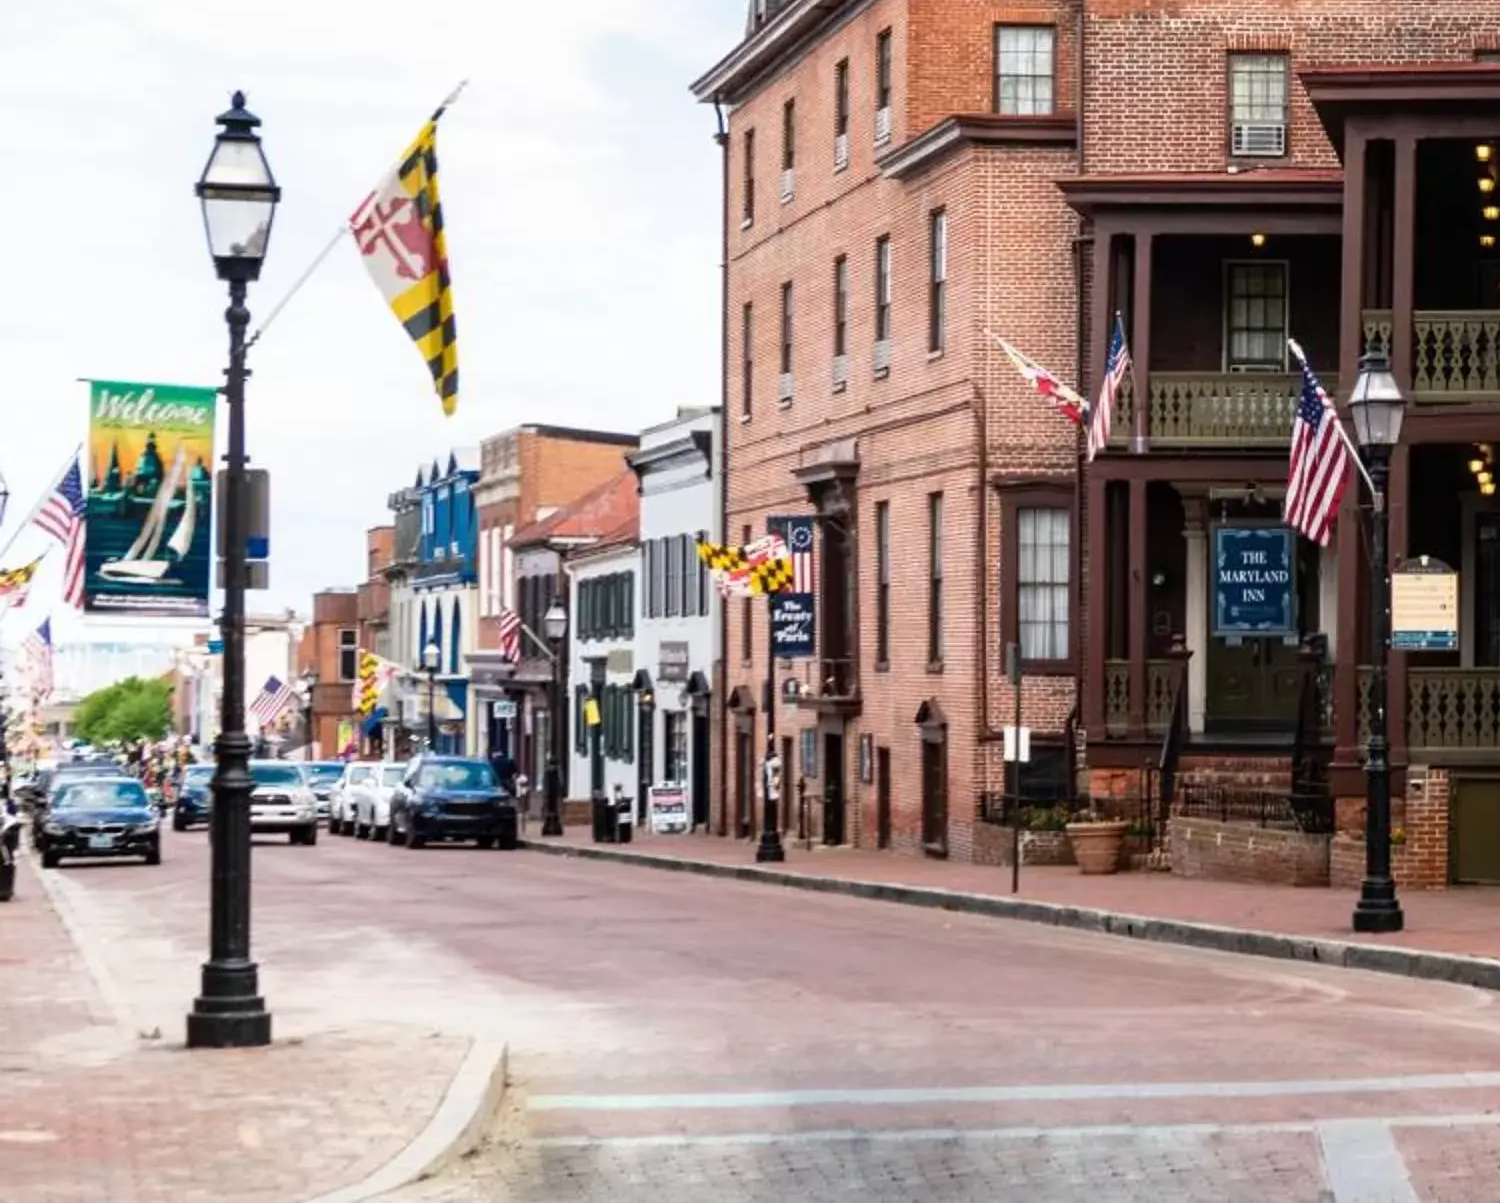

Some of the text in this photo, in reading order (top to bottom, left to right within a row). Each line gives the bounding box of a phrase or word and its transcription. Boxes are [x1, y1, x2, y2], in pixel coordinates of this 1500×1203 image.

[95, 388, 206, 425] Welcome
[1241, 550, 1268, 565] THE
[1219, 569, 1289, 584] MARYLAND
[1242, 588, 1265, 602] INN
